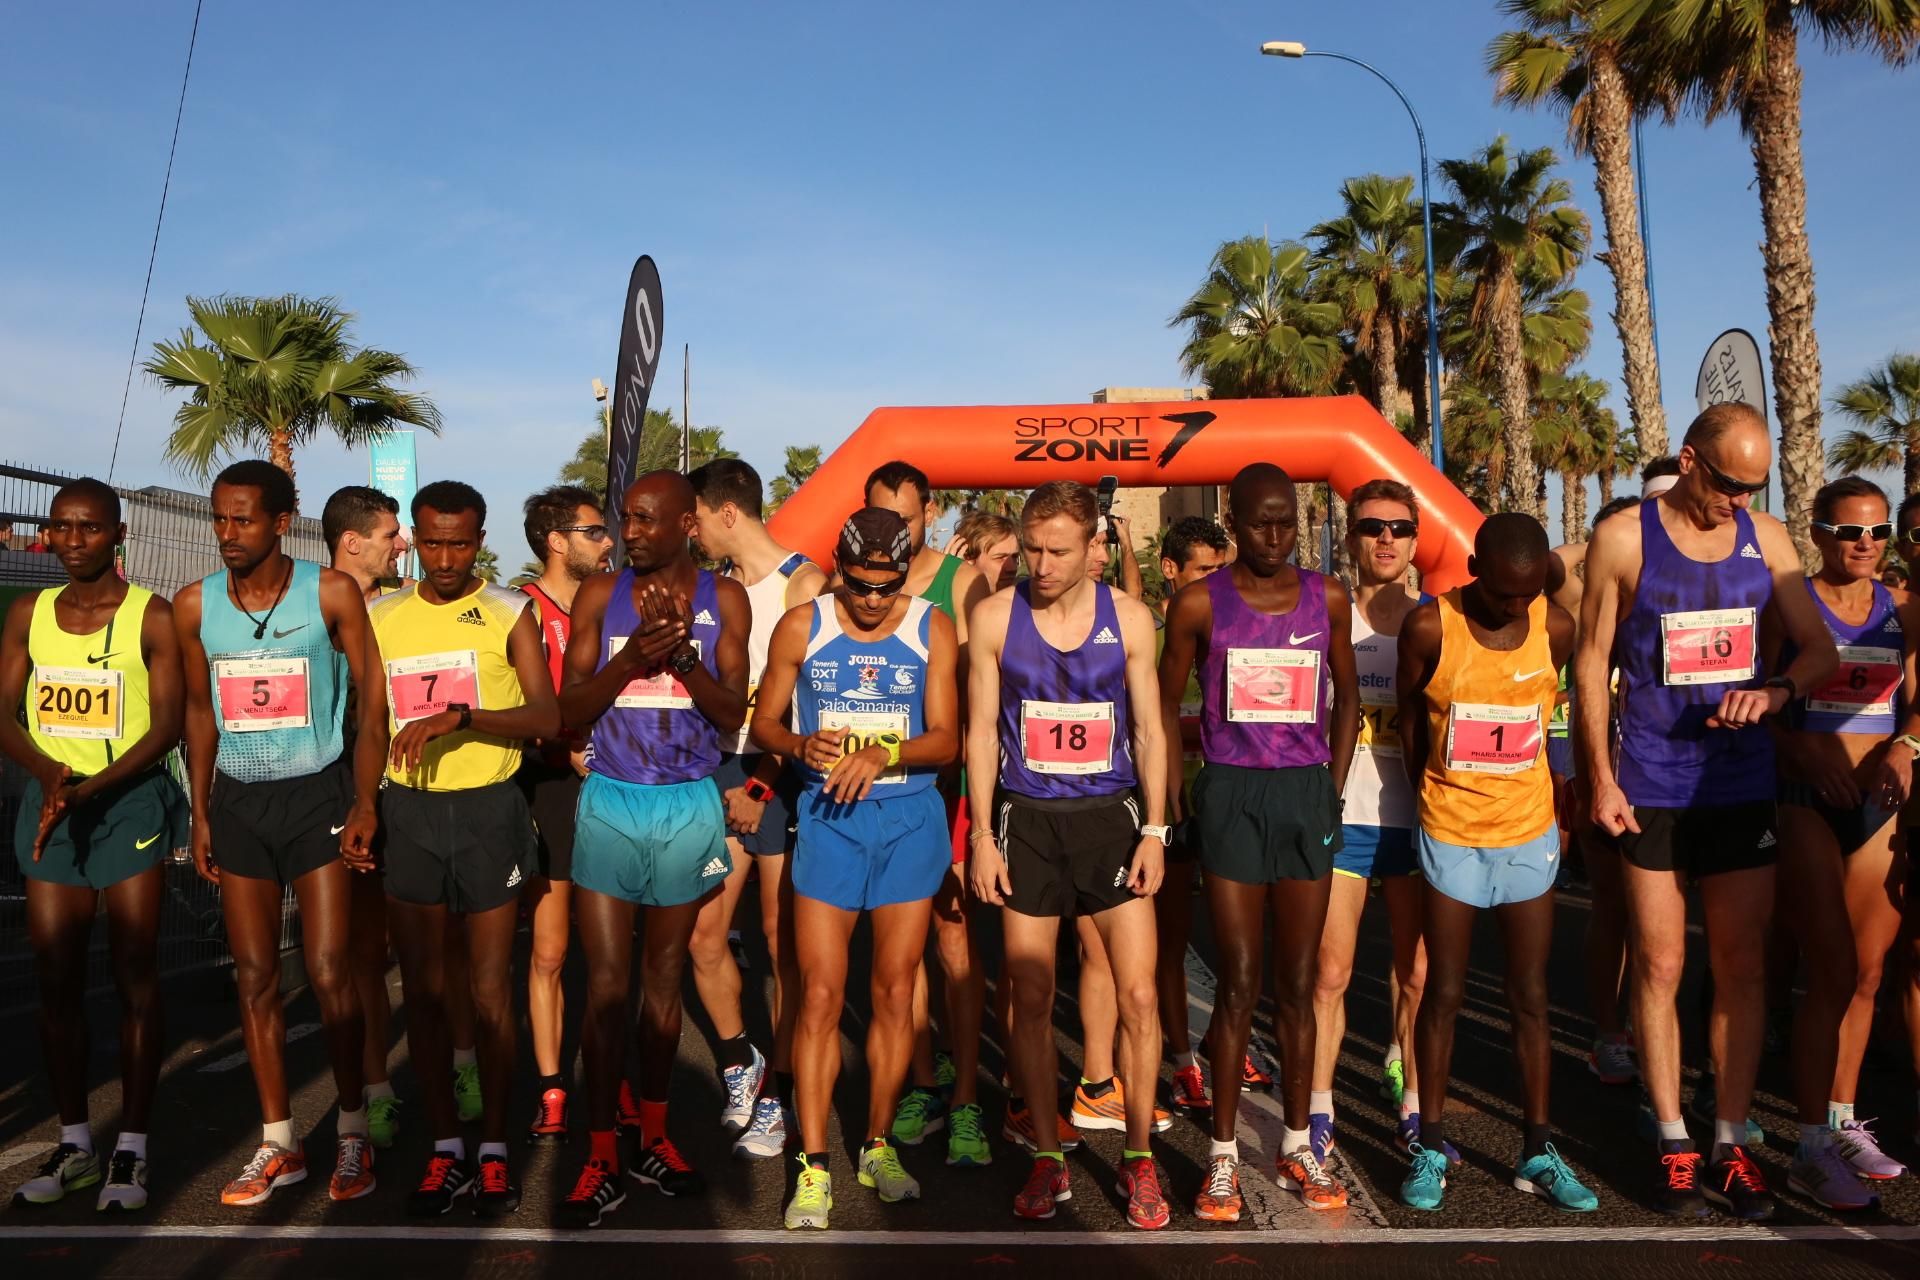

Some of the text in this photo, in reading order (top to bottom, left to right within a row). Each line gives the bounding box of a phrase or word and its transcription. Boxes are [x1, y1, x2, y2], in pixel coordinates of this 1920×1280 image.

[1014, 416, 1151, 437] SPORT
[1014, 438, 1151, 462] ZONE
[456, 616, 487, 627] adidas
[1699, 631, 1732, 658] 16
[812, 660, 839, 668] Tenerife
[811, 668, 838, 679] DXT
[1357, 672, 1392, 688] ster
[1849, 666, 1868, 690] 6
[252, 680, 270, 707] 5
[421, 674, 438, 702] 7
[39, 685, 110, 716] 2001
[265, 704, 288, 713] TSEGA
[412, 703, 433, 712] AWOL
[818, 698, 911, 713] CajaCanarias
[58, 713, 89, 722] EZEQUIEL
[1049, 723, 1087, 751] 18
[1490, 725, 1504, 752] 1
[702, 866, 729, 878] adidas
